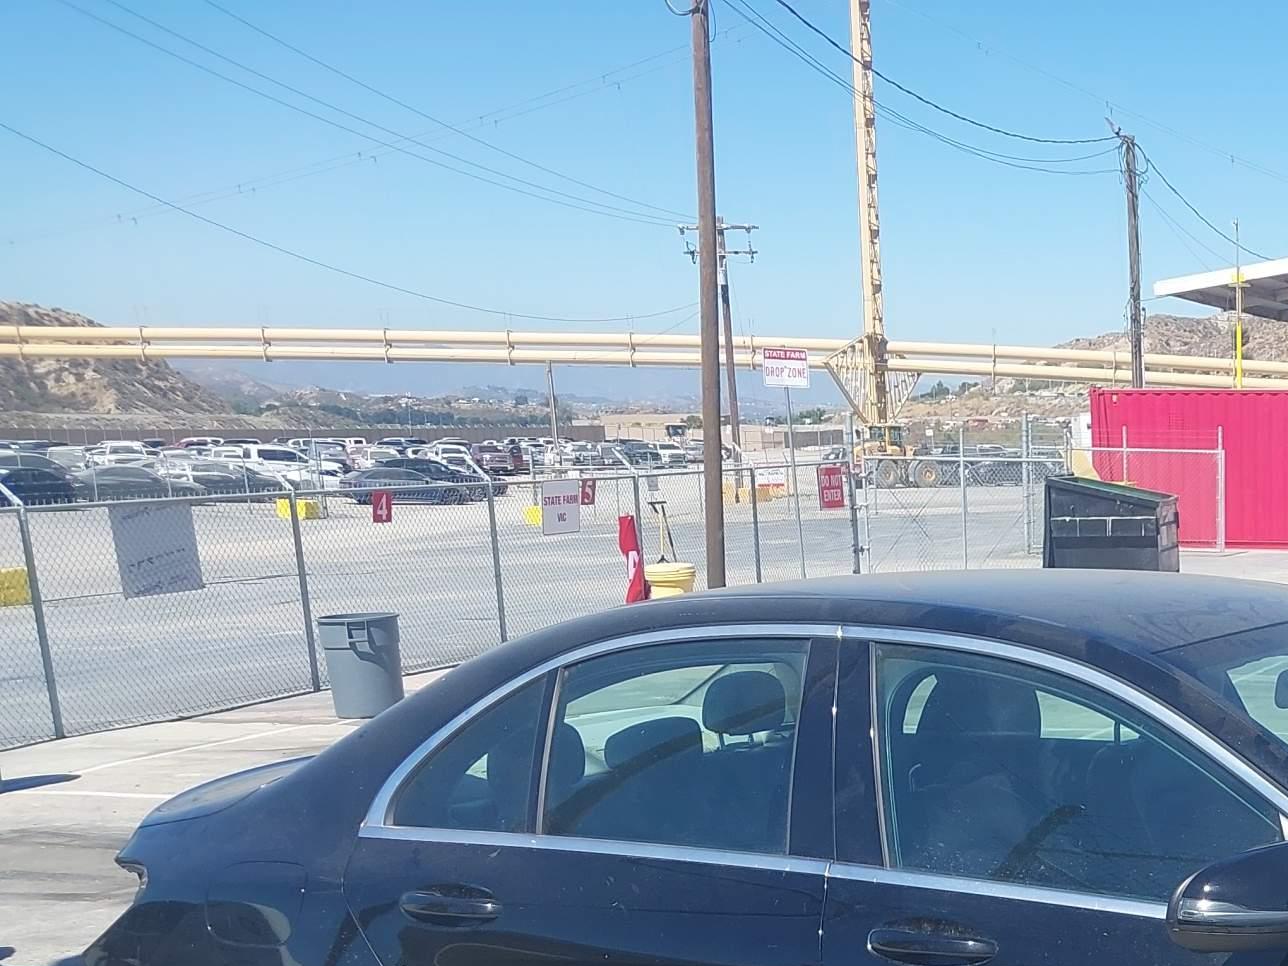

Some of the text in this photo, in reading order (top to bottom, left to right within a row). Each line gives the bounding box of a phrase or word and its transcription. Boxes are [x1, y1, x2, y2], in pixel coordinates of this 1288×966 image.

[765, 350, 806, 360] STATE FARM
[765, 366, 807, 379] DROP ZONE
[821, 474, 843, 488] DO NOT
[584, 480, 593, 504] 5
[823, 489, 842, 502] ENTER
[377, 493, 388, 520] 4
[543, 495, 562, 506] STATE
